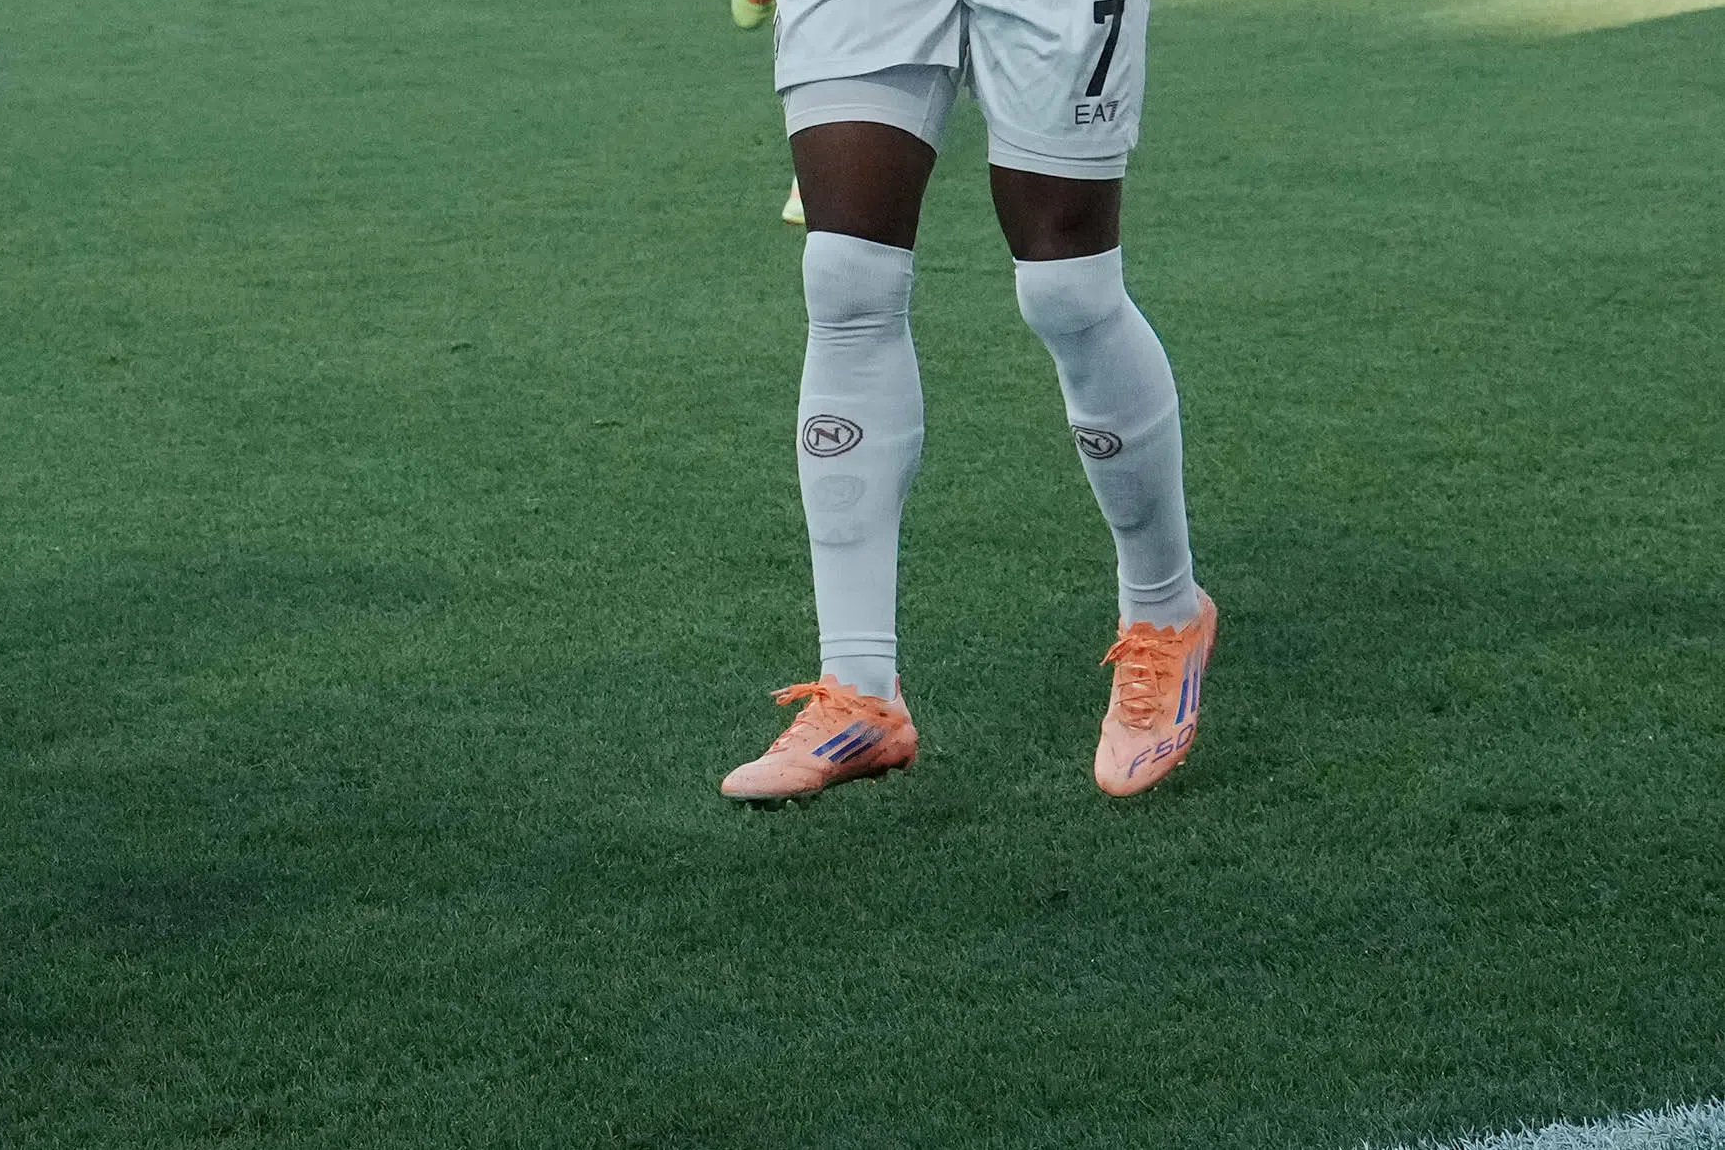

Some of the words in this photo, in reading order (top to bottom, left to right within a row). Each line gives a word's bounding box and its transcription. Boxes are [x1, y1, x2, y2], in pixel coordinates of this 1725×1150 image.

[1075, 100, 1119, 125] EA7
[812, 427, 841, 447] N
[1128, 723, 1194, 778] F50
